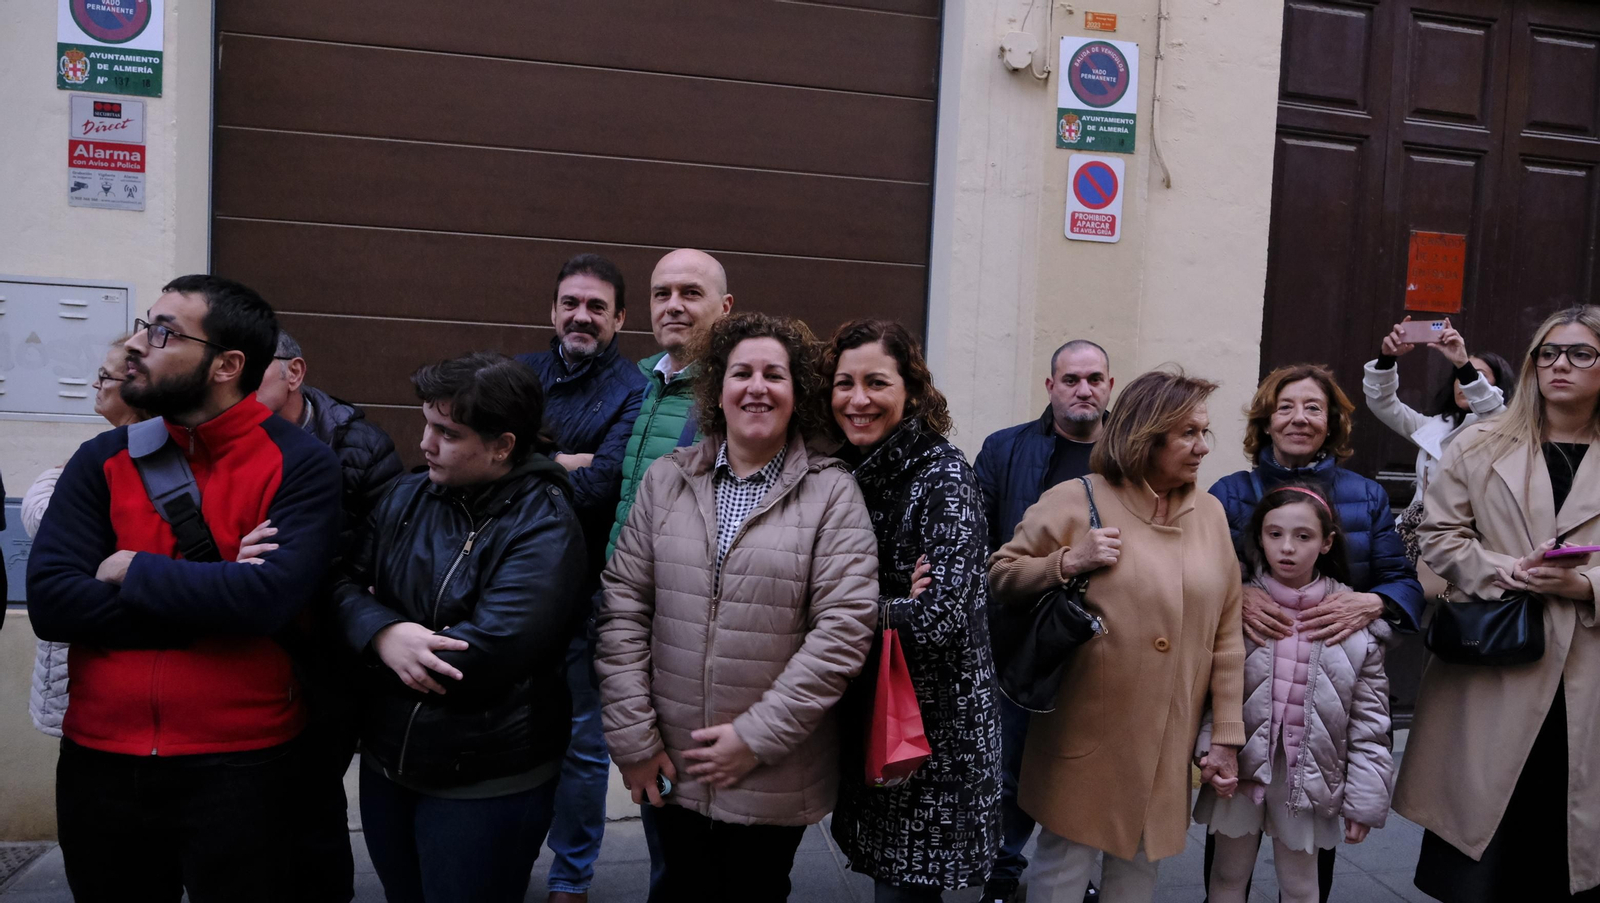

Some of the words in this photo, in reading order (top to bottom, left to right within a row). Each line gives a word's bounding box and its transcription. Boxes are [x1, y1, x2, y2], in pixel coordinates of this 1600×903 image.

[86, 3, 134, 15] PERMANENTE
[89, 52, 160, 64] AYUNTAMIENTO
[1074, 49, 1090, 67] SALIDA
[1101, 47, 1125, 72] VEHICULOS
[97, 63, 109, 71] DE
[113, 65, 153, 74] ALMERÍA
[1092, 68, 1107, 76] VADO
[1080, 73, 1117, 83] PERMANENTE
[1081, 115, 1134, 125] AYUNTAMIENTO
[82, 118, 135, 135] Direct
[1098, 125, 1129, 134] ALMERÍA
[73, 144, 141, 161] Alarma
[116, 161, 141, 170] Policía
[1074, 213, 1112, 222] PROHIBIDO
[1076, 220, 1110, 230] APARCAR
[928, 849, 965, 860] vwx
